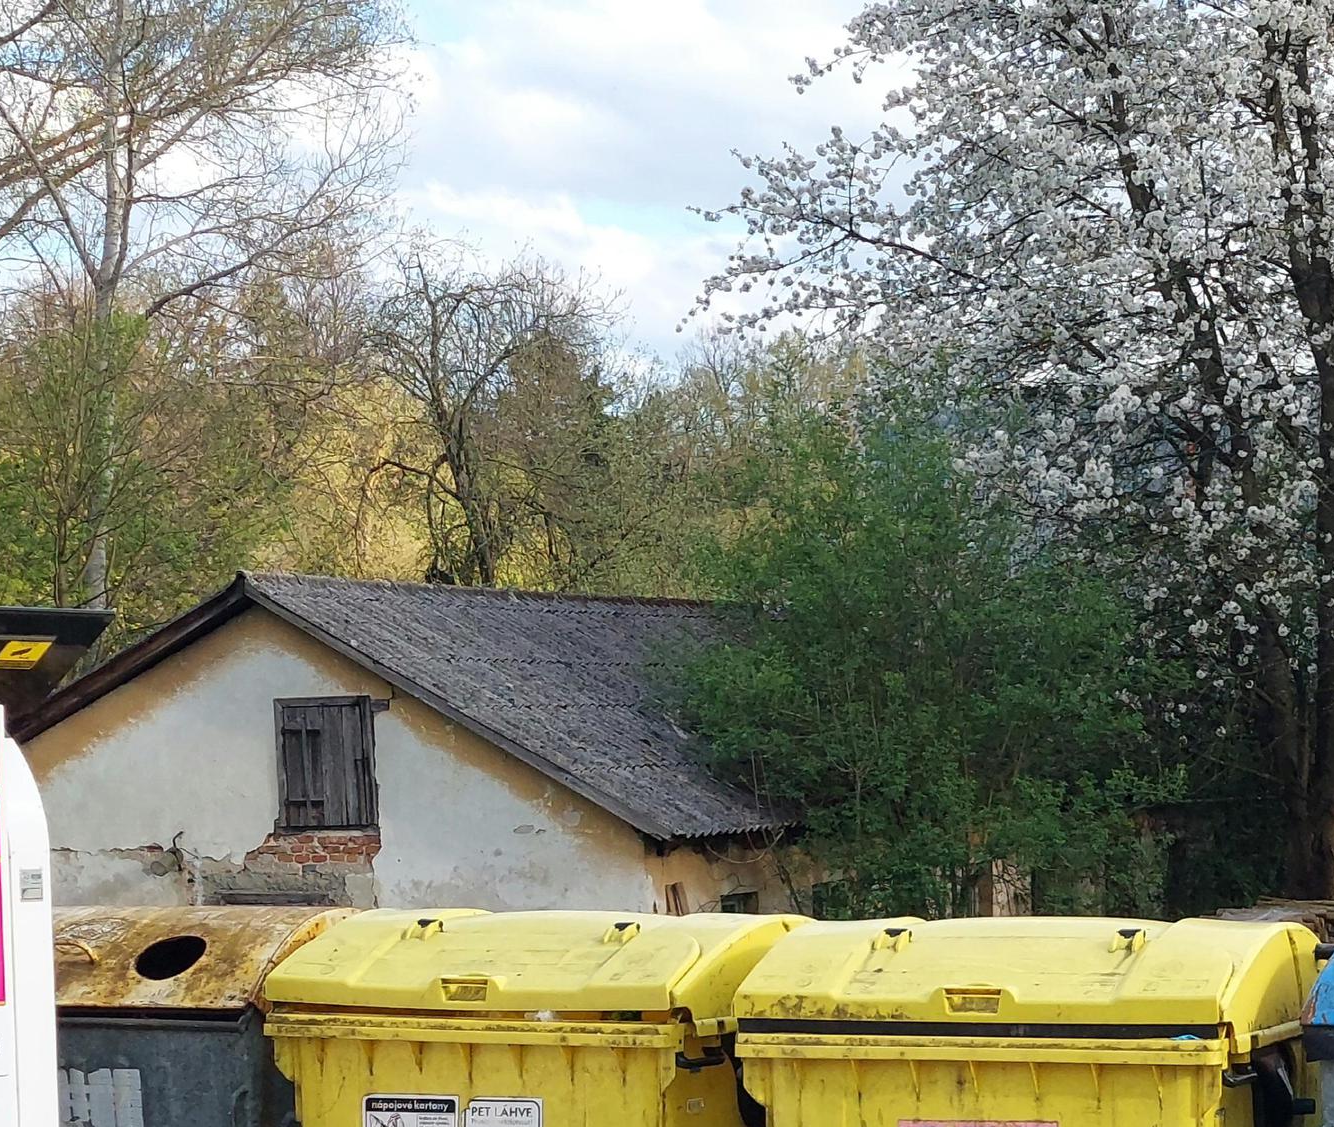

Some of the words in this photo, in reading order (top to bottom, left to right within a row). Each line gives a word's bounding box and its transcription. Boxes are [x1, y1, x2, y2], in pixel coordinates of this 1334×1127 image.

[372, 1101, 413, 1112] nápojové
[414, 1101, 449, 1112] kartony
[472, 1106, 491, 1117] PET
